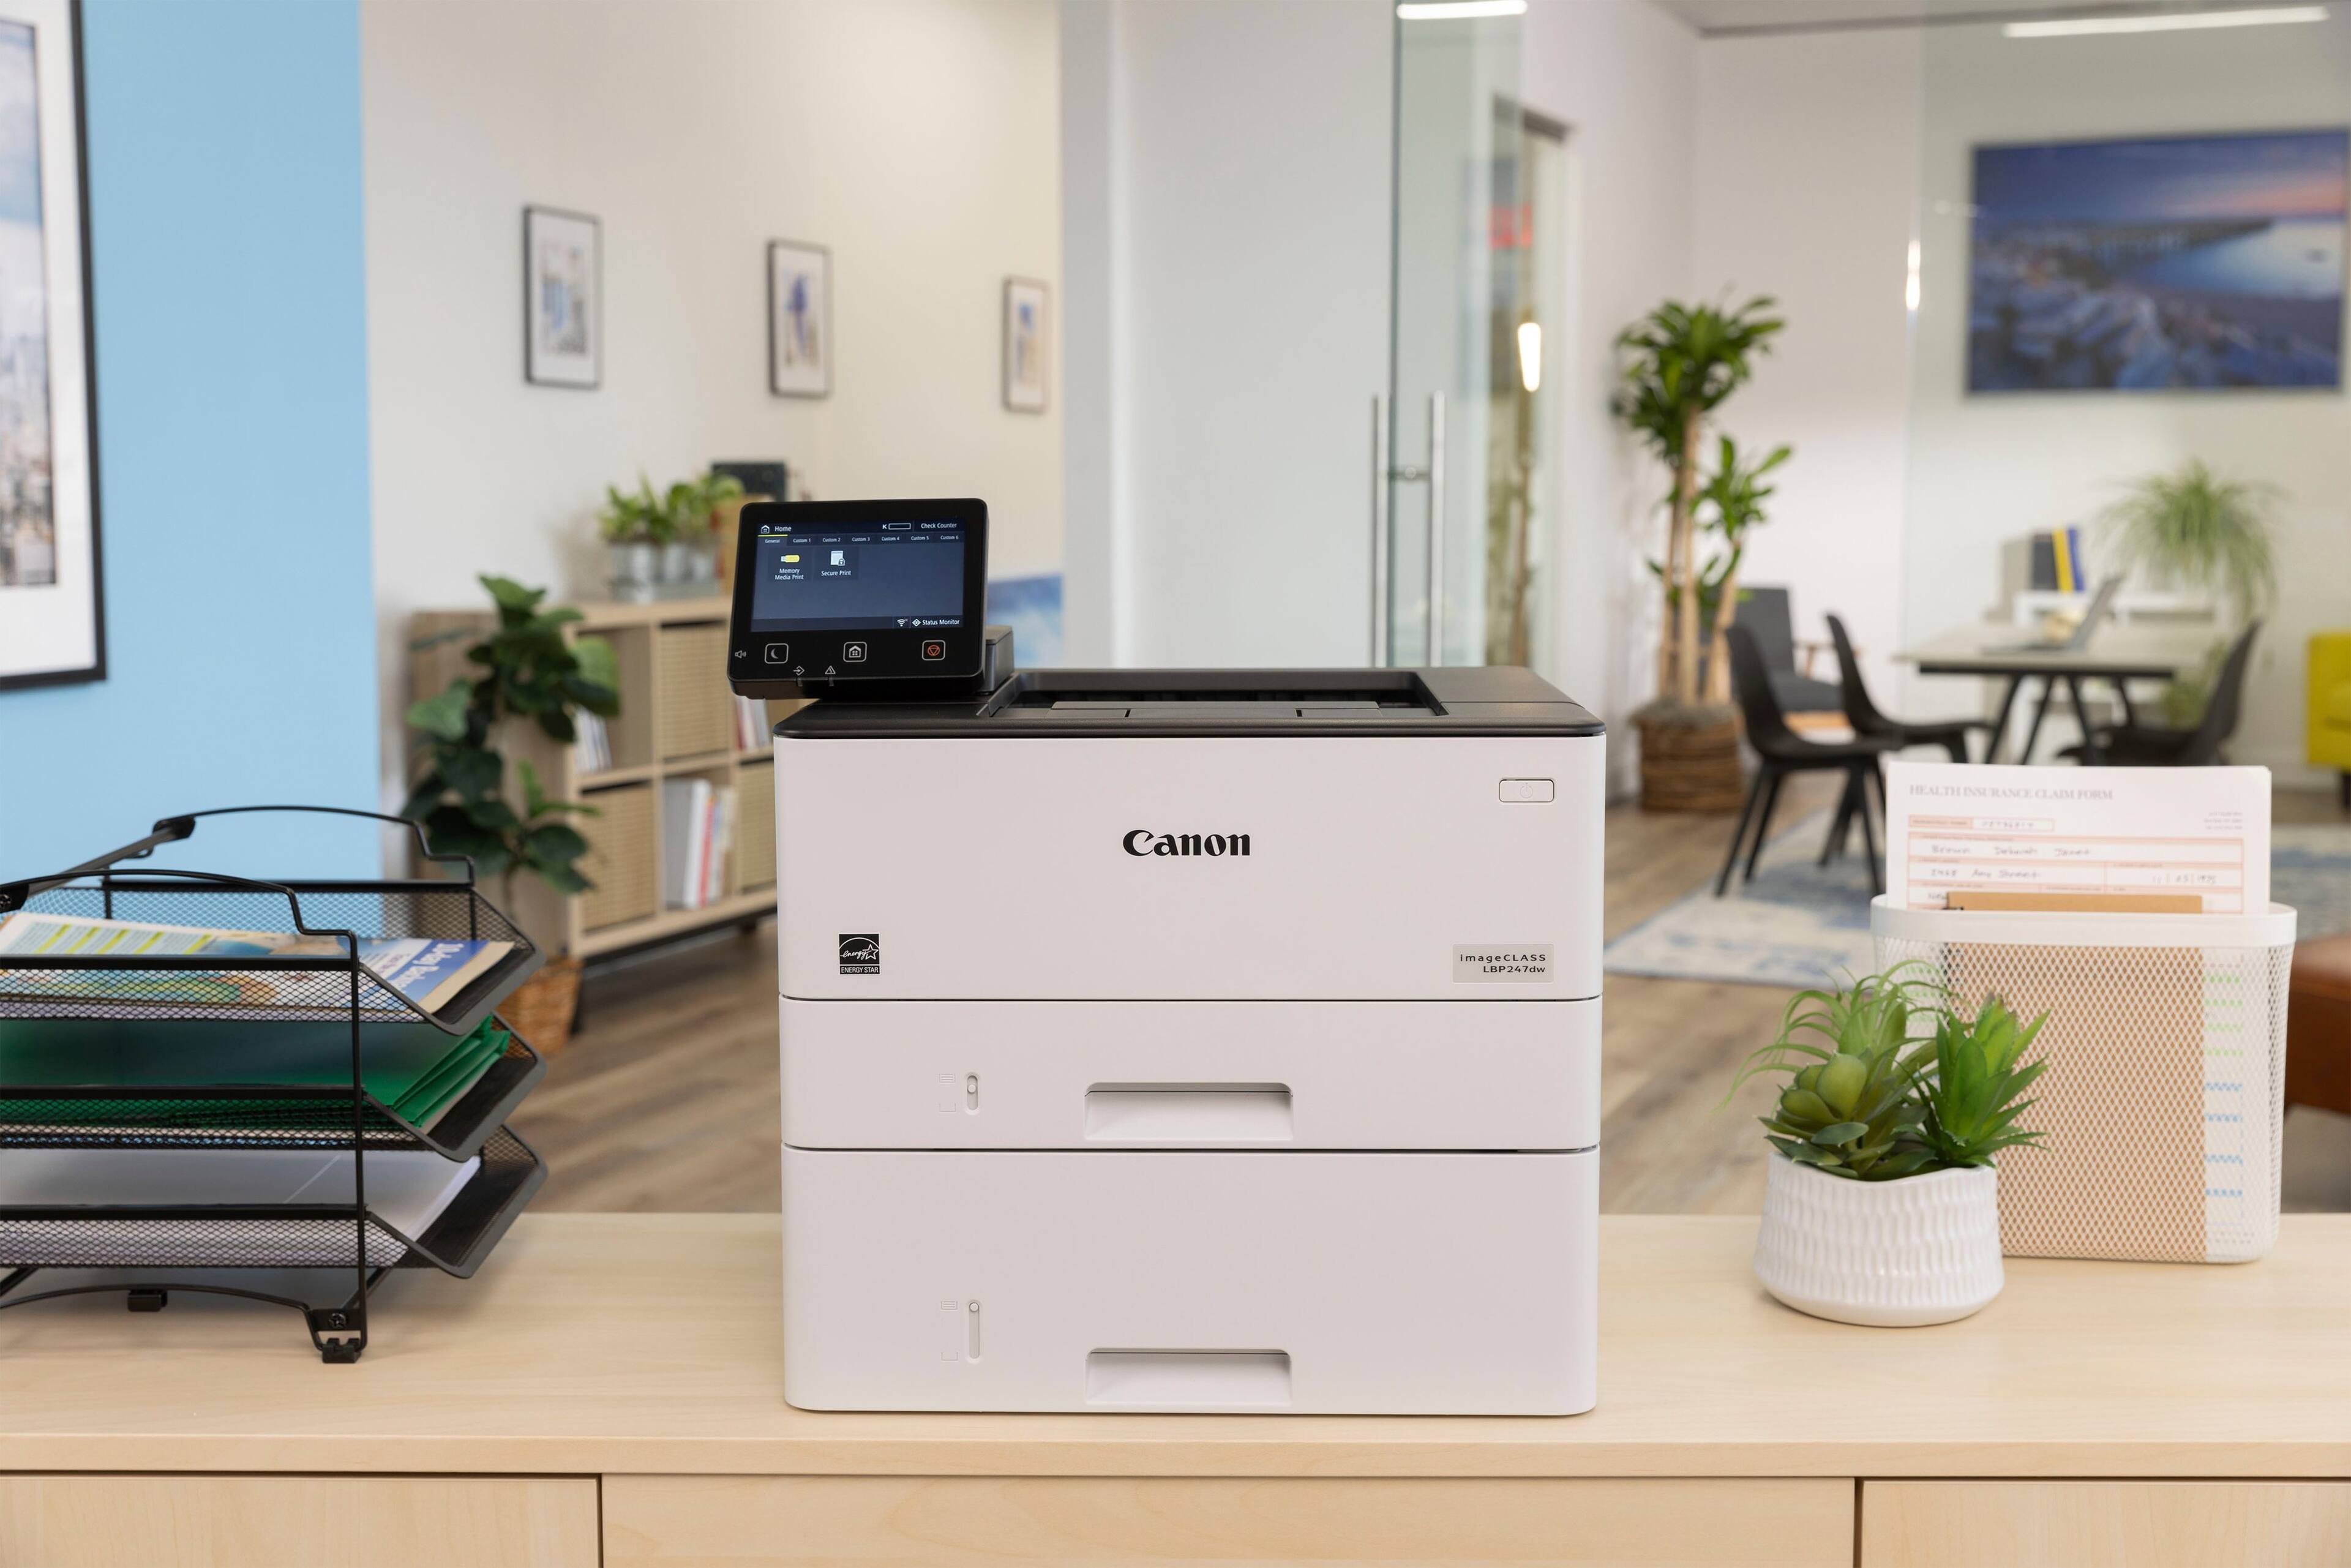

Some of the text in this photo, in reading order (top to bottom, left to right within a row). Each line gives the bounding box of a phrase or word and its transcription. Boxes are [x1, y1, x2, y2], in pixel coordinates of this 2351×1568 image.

[1909, 784, 2113, 800] HEALTH INSURANCE CLAIM FORM
[1123, 830, 1250, 857] Canon
[1460, 954, 1546, 964] imageCLASS
